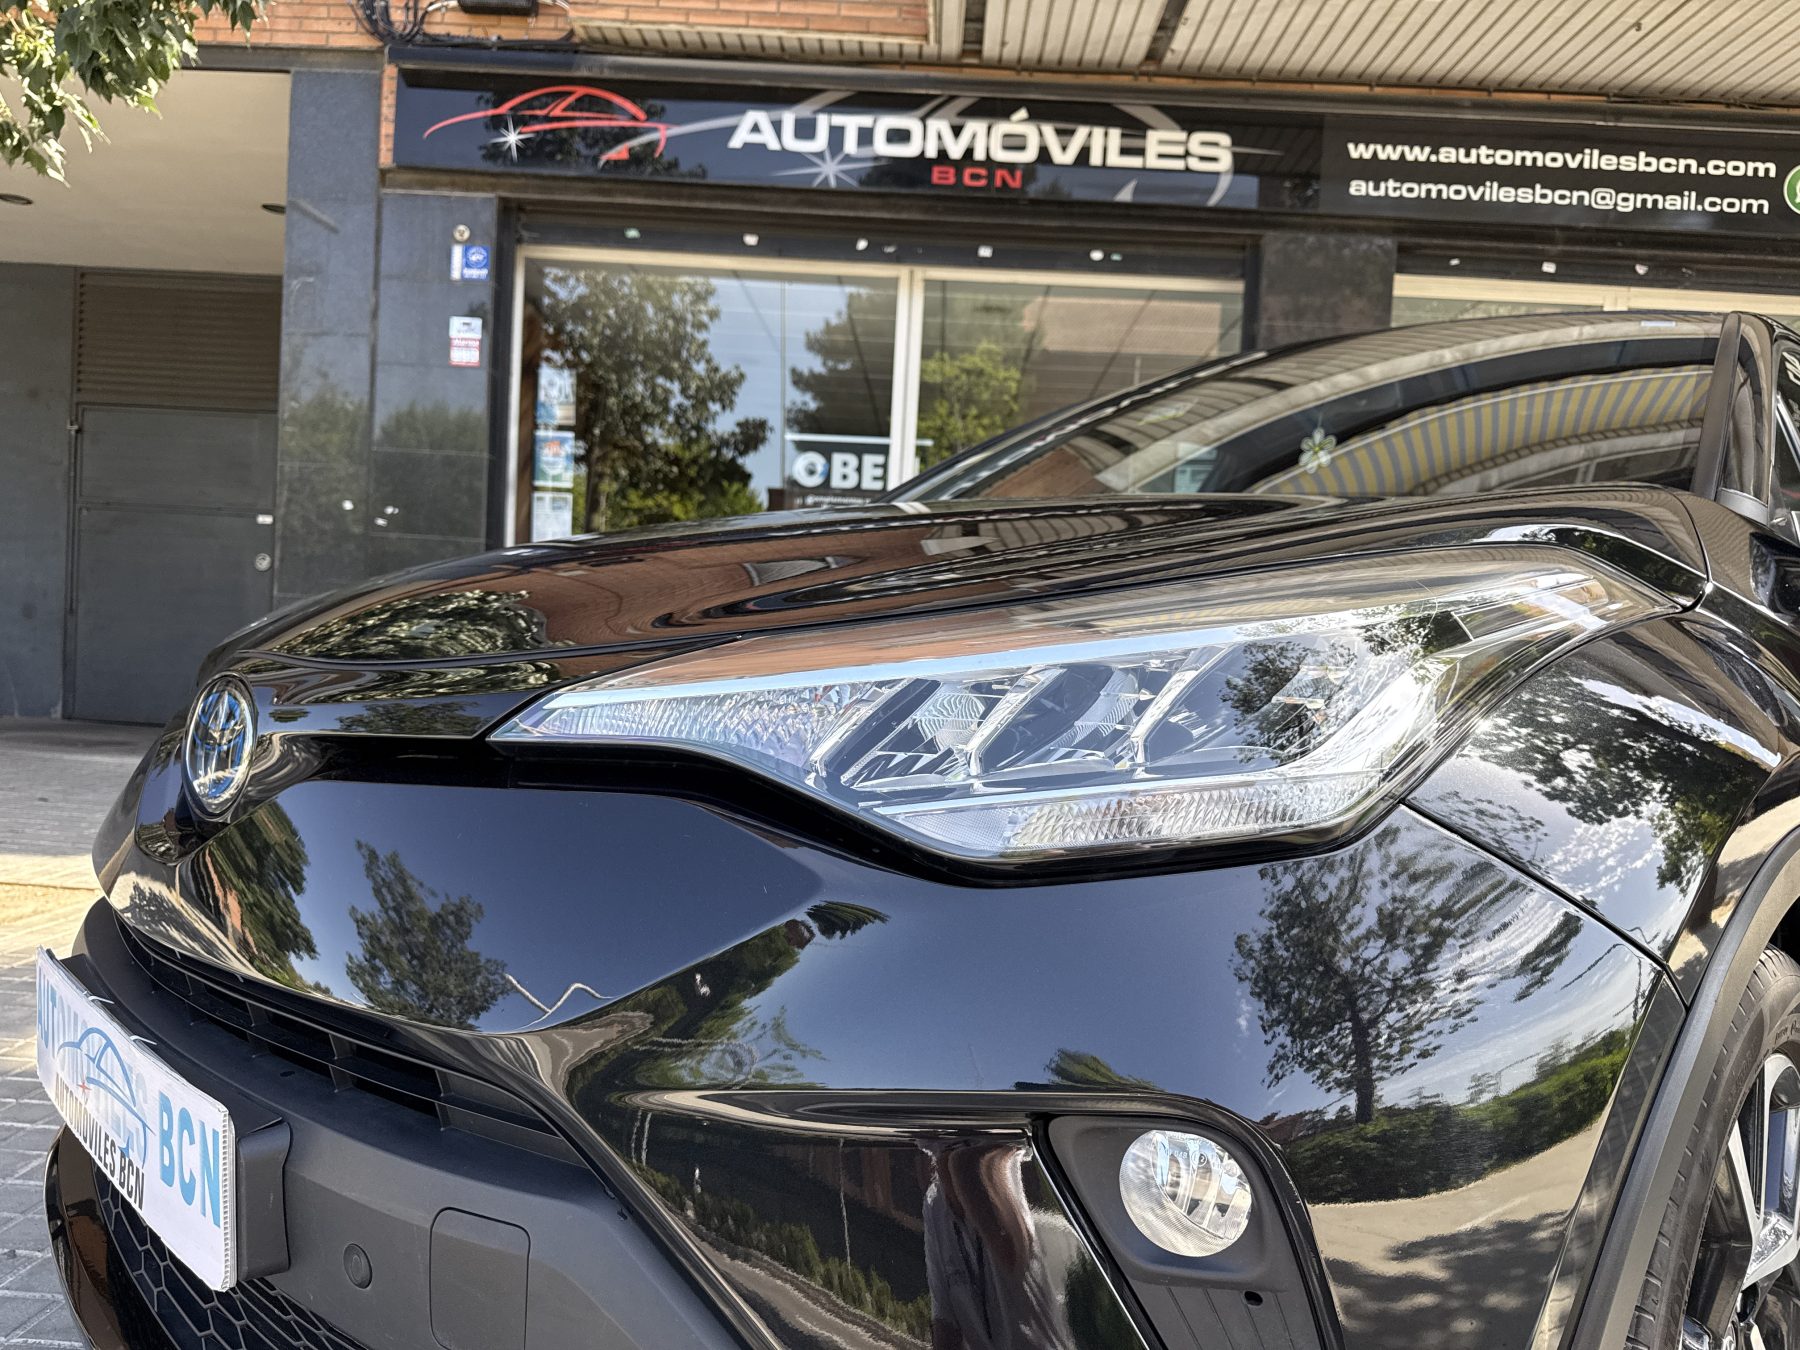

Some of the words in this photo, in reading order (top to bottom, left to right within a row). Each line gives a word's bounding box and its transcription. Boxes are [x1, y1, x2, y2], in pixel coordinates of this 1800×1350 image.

[728, 107, 1233, 173] AUTOMÓVILES
[1347, 140, 1777, 179] www.automovilesbcn.com
[930, 164, 1023, 190] BCN
[1348, 176, 1770, 215] automovilesbcn@gmail.com
[791, 450, 887, 491] OBE
[158, 1089, 222, 1229] BCN
[118, 1150, 145, 1212] BCN
